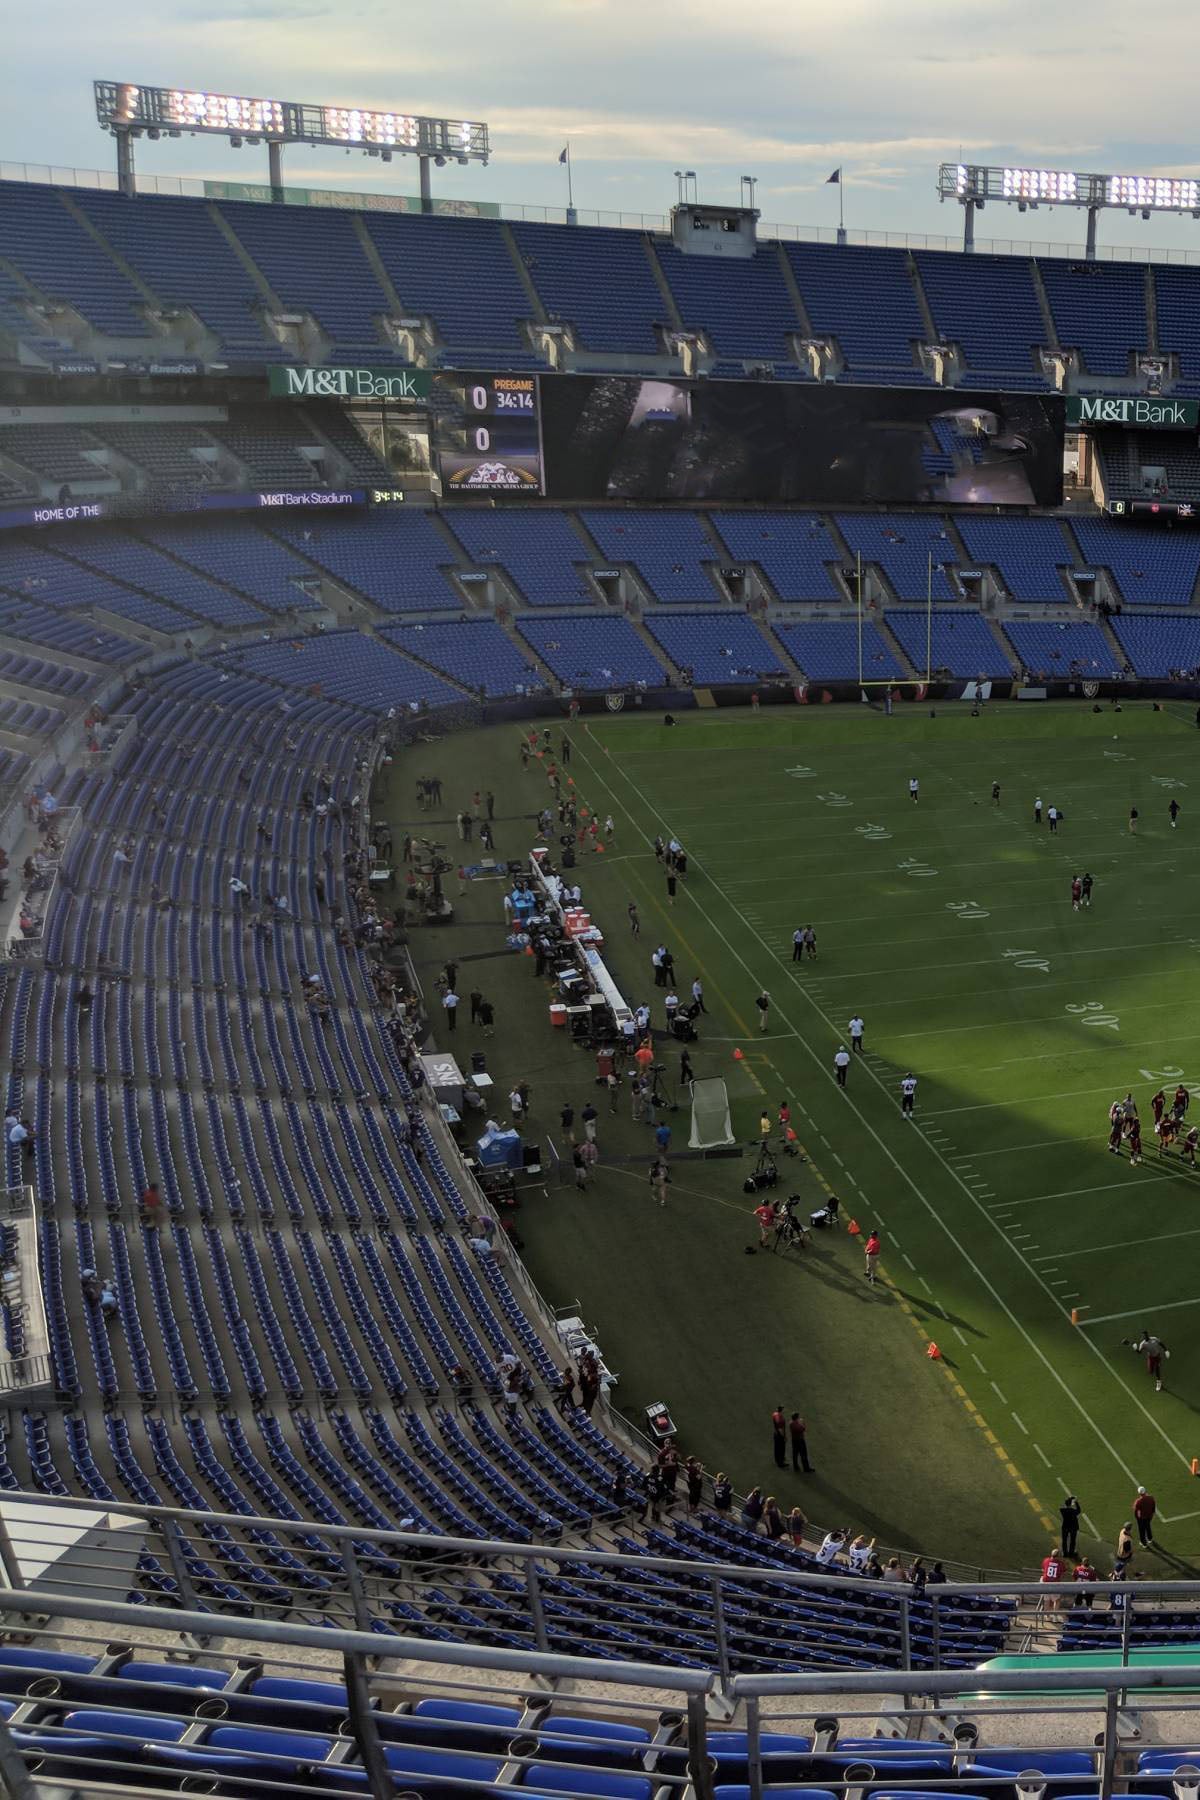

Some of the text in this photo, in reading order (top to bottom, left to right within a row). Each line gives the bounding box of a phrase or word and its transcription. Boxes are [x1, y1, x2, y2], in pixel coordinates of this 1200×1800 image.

[286, 368, 417, 397] M&T Bank
[494, 379, 534, 391] PREGAME
[472, 386, 487, 410] 0
[497, 392, 534, 409] 34:14
[1080, 397, 1186, 424] M&T Bank
[475, 427, 490, 451] 0
[260, 492, 352, 506] M&T Bank Stadium
[375, 491, 404, 503] 34:14
[34, 504, 99, 522] HOME OF THE
[945, 901, 990, 919] 50
[1001, 949, 1050, 968] 40
[1065, 1001, 1120, 1026] 30
[1047, 1566, 1058, 1578] 81
